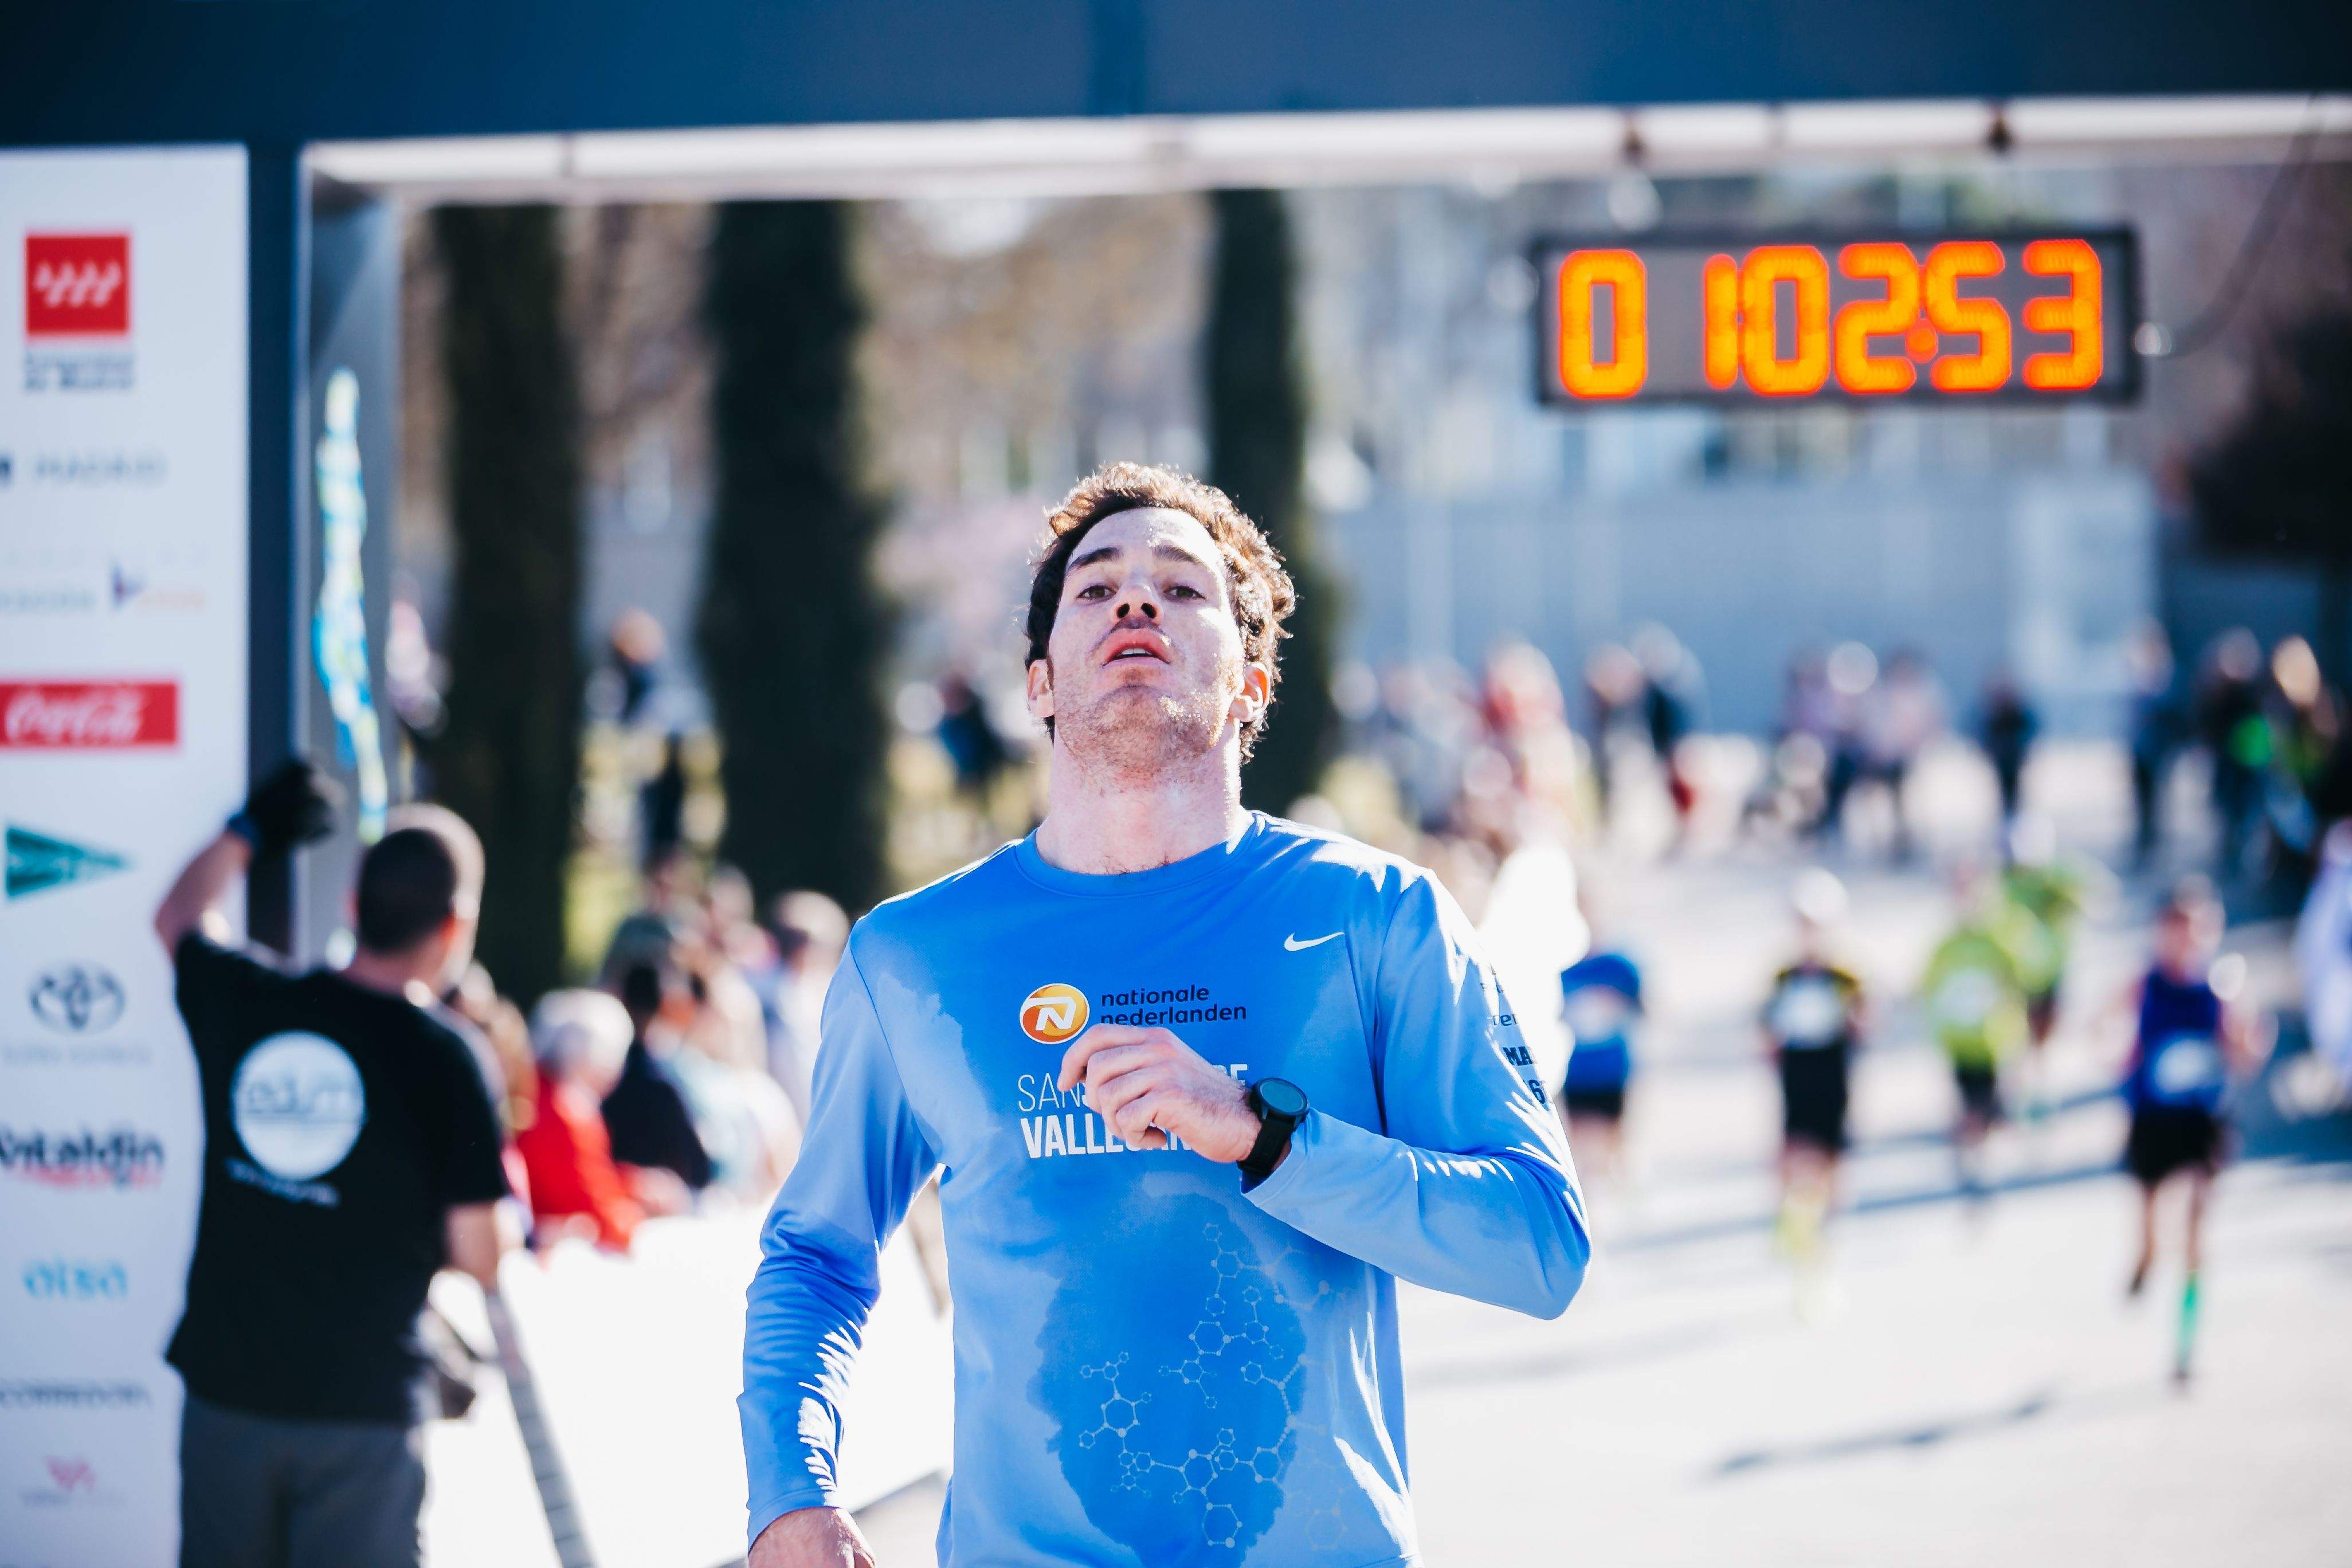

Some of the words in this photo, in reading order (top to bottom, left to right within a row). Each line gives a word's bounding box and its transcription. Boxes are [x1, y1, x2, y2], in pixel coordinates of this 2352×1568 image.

[1101, 984, 1210, 1008] nationale
[1100, 1004, 1247, 1026] nederlanden
[1020, 1113, 1192, 1159] VALLE
